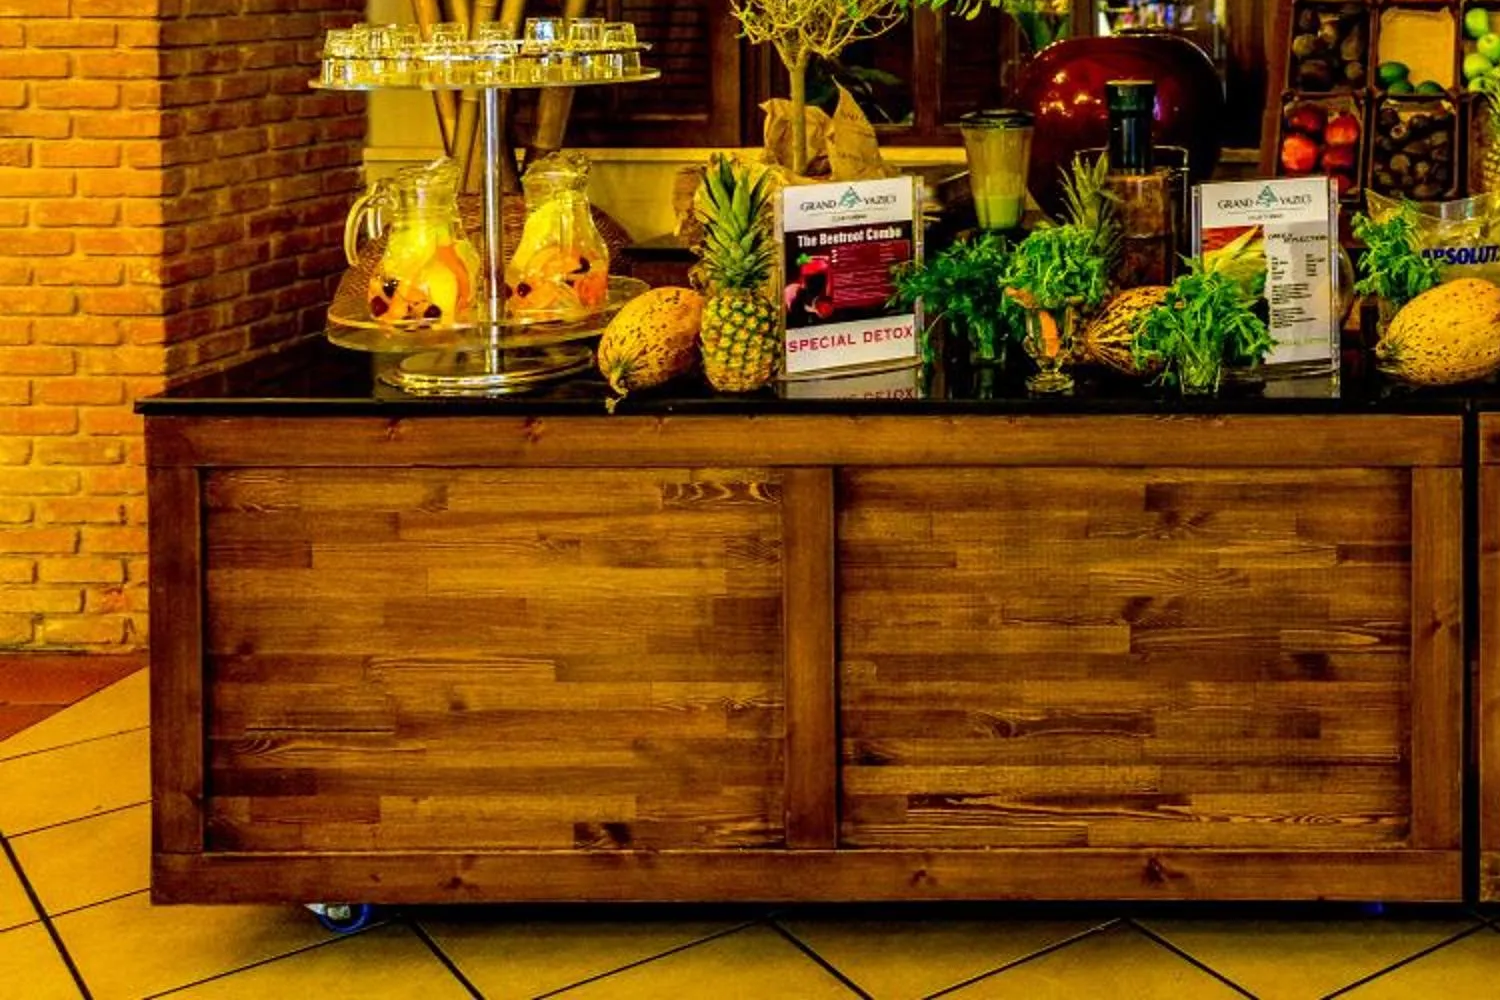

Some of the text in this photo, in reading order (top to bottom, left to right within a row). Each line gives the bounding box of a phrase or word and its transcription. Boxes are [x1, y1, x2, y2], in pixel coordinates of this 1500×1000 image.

[800, 200, 837, 212] GRAND
[797, 234, 818, 248] The
[788, 324, 914, 353] SPECIAL DETOX
